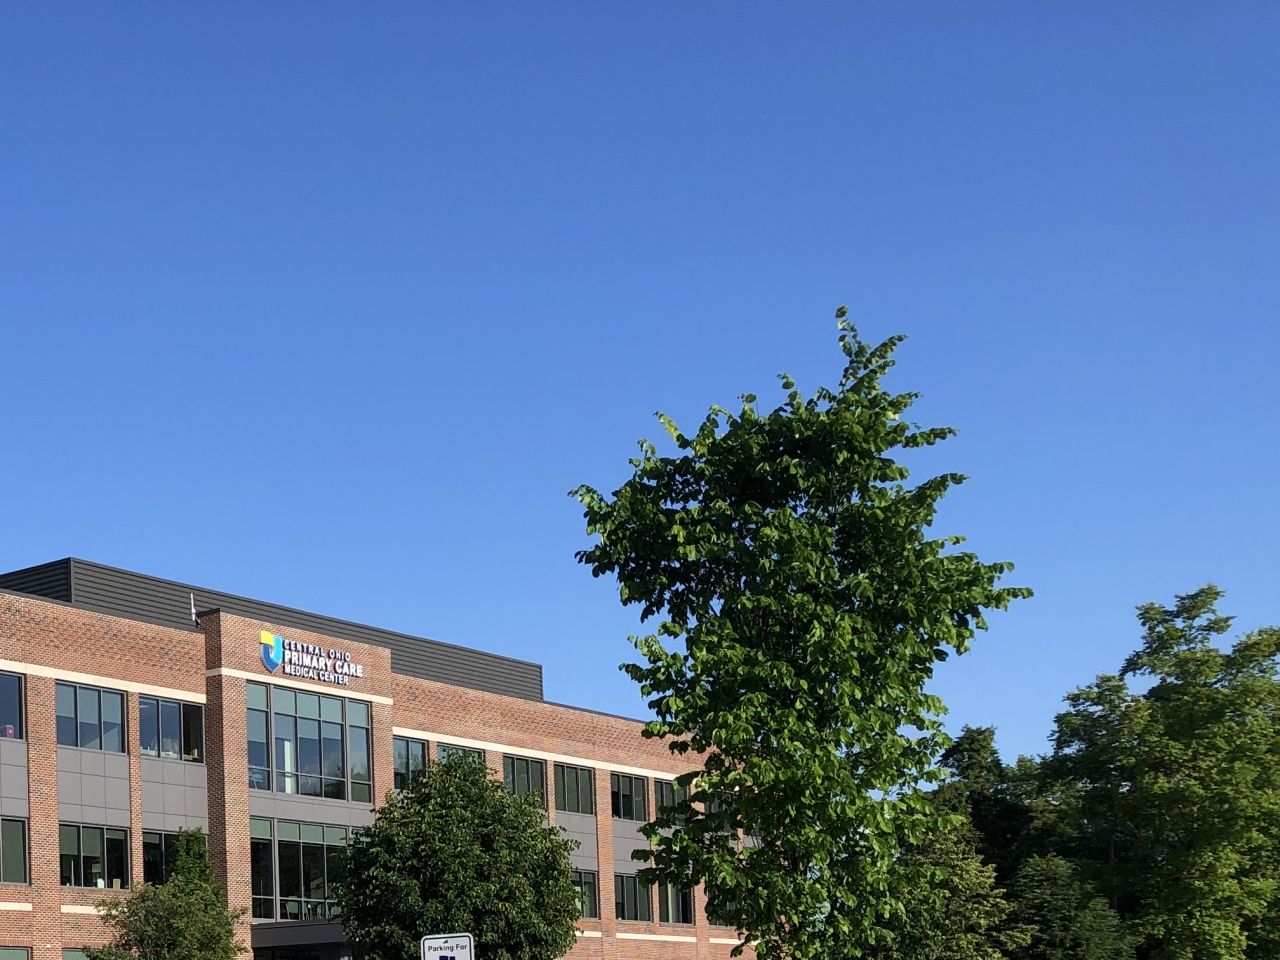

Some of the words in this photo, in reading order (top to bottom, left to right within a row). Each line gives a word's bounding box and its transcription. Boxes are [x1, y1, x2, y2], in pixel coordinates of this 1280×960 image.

[283, 640, 325, 656] CENTRAL
[328, 649, 351, 662] OHIO
[283, 650, 334, 671] PRIMARY
[334, 661, 364, 677] CARE
[283, 664, 319, 679] MEDICAL
[319, 671, 349, 684] CENTER
